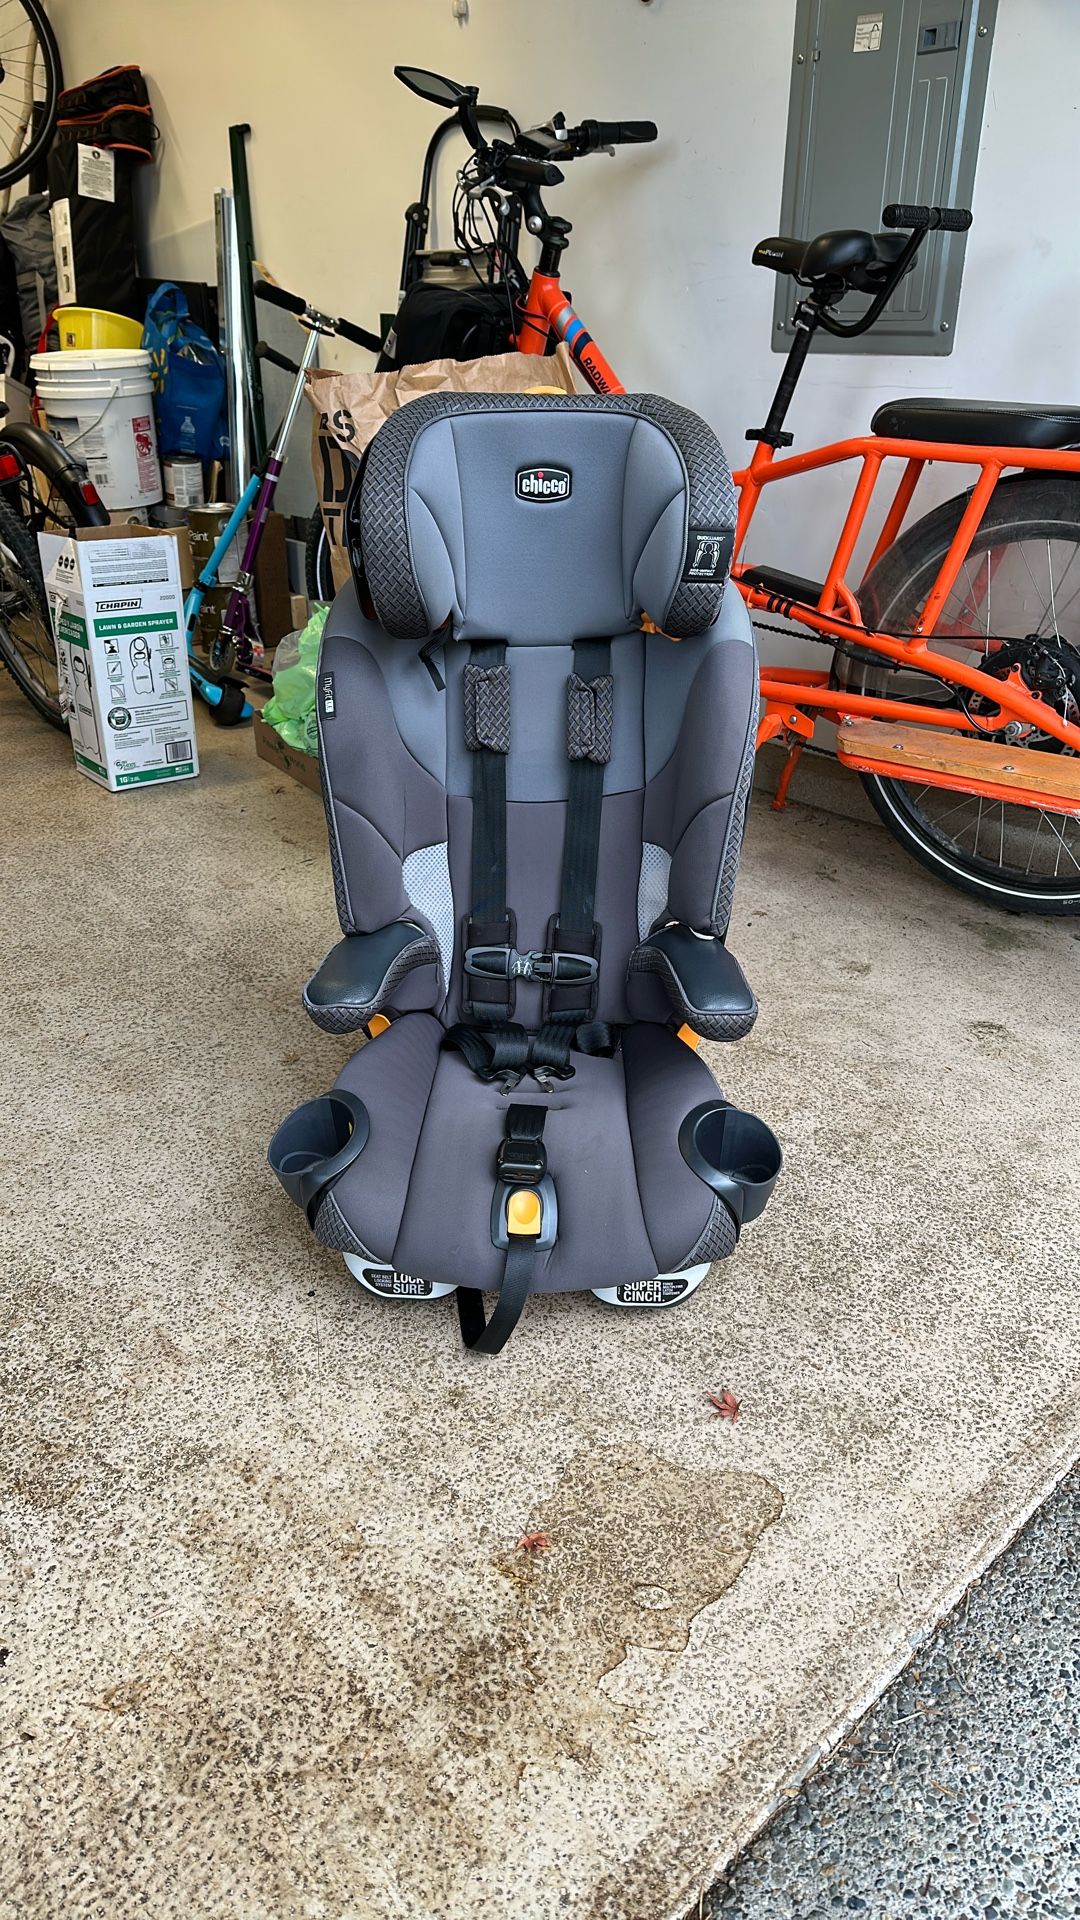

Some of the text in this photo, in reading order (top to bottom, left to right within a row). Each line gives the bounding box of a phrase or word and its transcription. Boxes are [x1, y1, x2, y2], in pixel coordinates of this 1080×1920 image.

[100, 600, 139, 610] CHAPIN
[98, 623, 117, 631] LAWN
[123, 620, 147, 628] GARDEN
[147, 617, 174, 626] SPRAYER
[624, 1281, 661, 1291] SUPER
